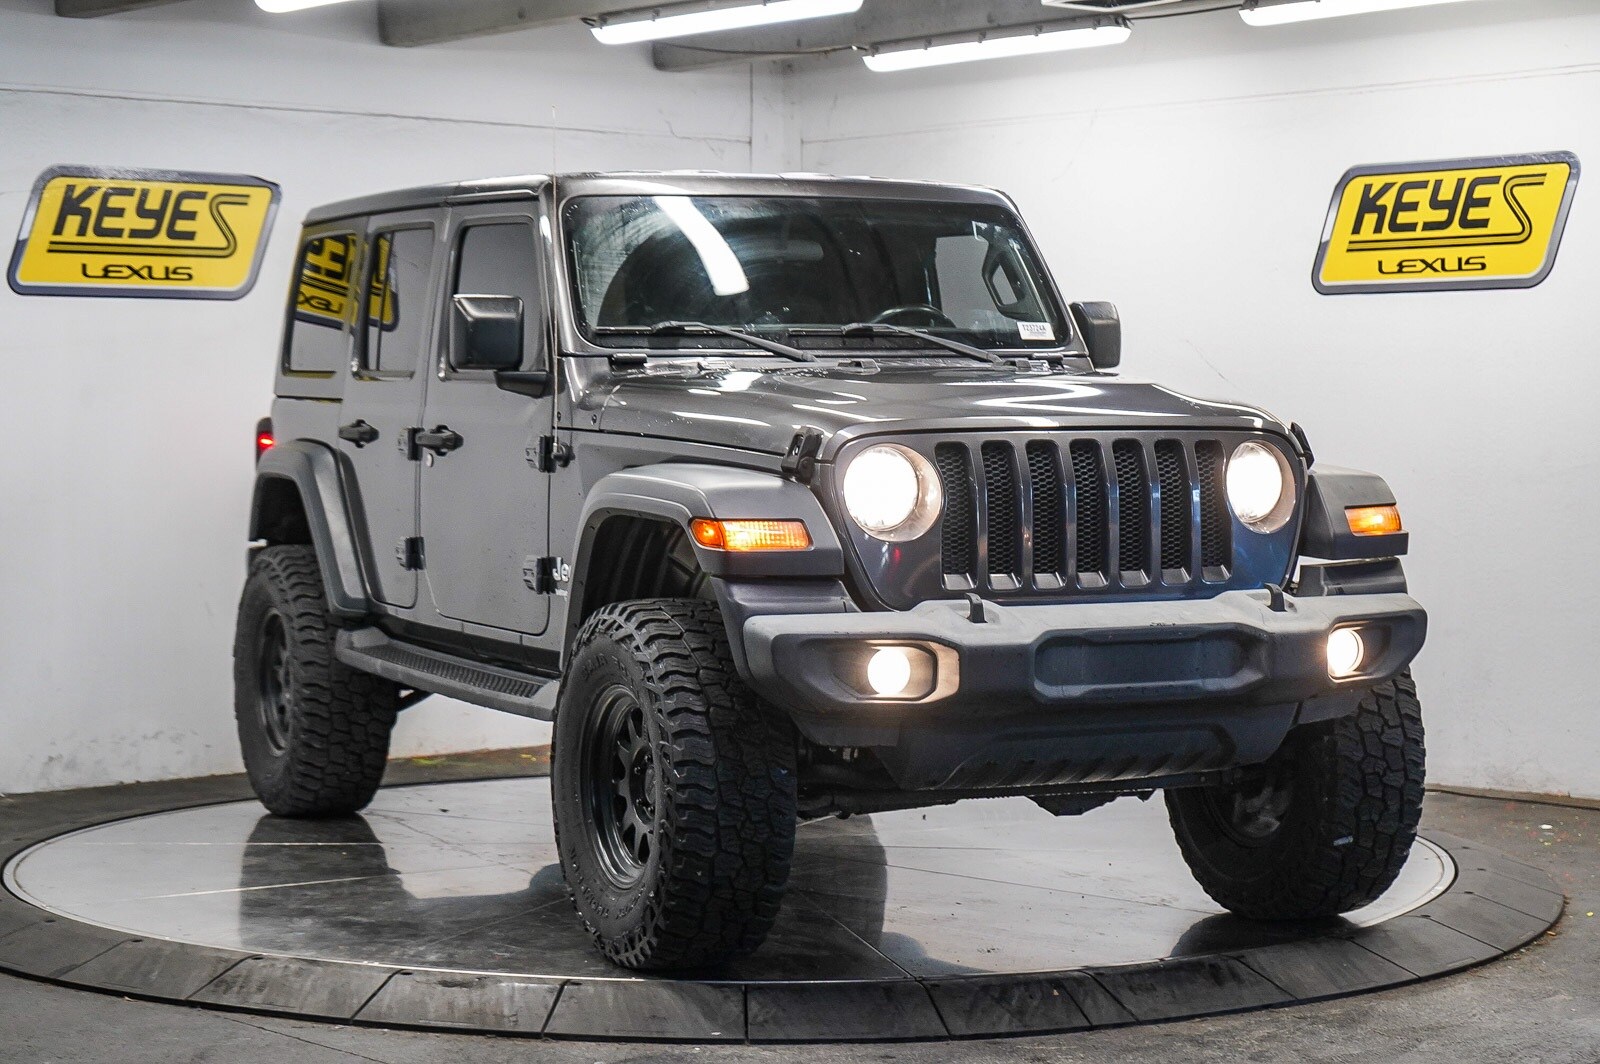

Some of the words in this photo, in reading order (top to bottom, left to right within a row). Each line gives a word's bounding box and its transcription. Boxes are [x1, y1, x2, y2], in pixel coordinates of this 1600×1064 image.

[50, 184, 250, 257] KEYES
[1350, 173, 1547, 246] KEYES
[81, 263, 193, 281] LEXUS
[1377, 256, 1487, 275] LEXUS
